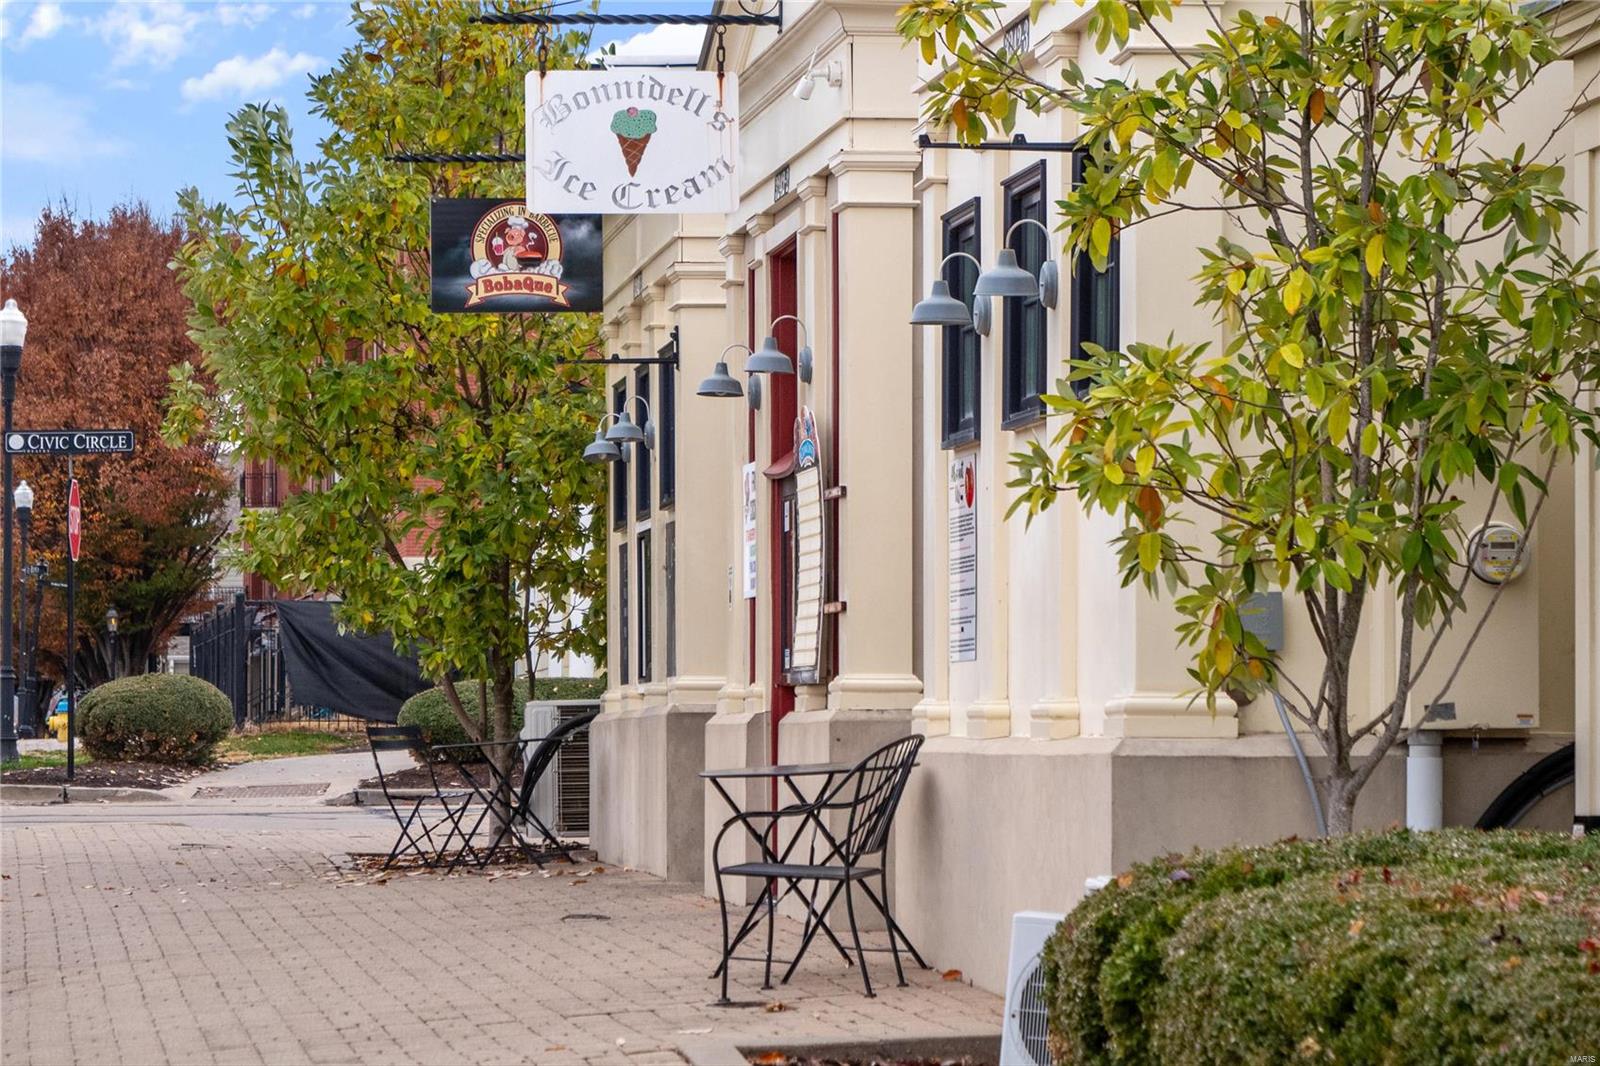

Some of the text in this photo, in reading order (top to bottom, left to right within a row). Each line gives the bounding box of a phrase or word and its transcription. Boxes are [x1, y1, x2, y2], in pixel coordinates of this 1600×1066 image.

[532, 150, 597, 201] Ice
[611, 155, 735, 210] Cream
[475, 206, 515, 243] SPECIALIZING
[518, 206, 526, 216] IN
[481, 276, 553, 294] BobaQue
[27, 433, 127, 450] CIVIC CIRCLE
